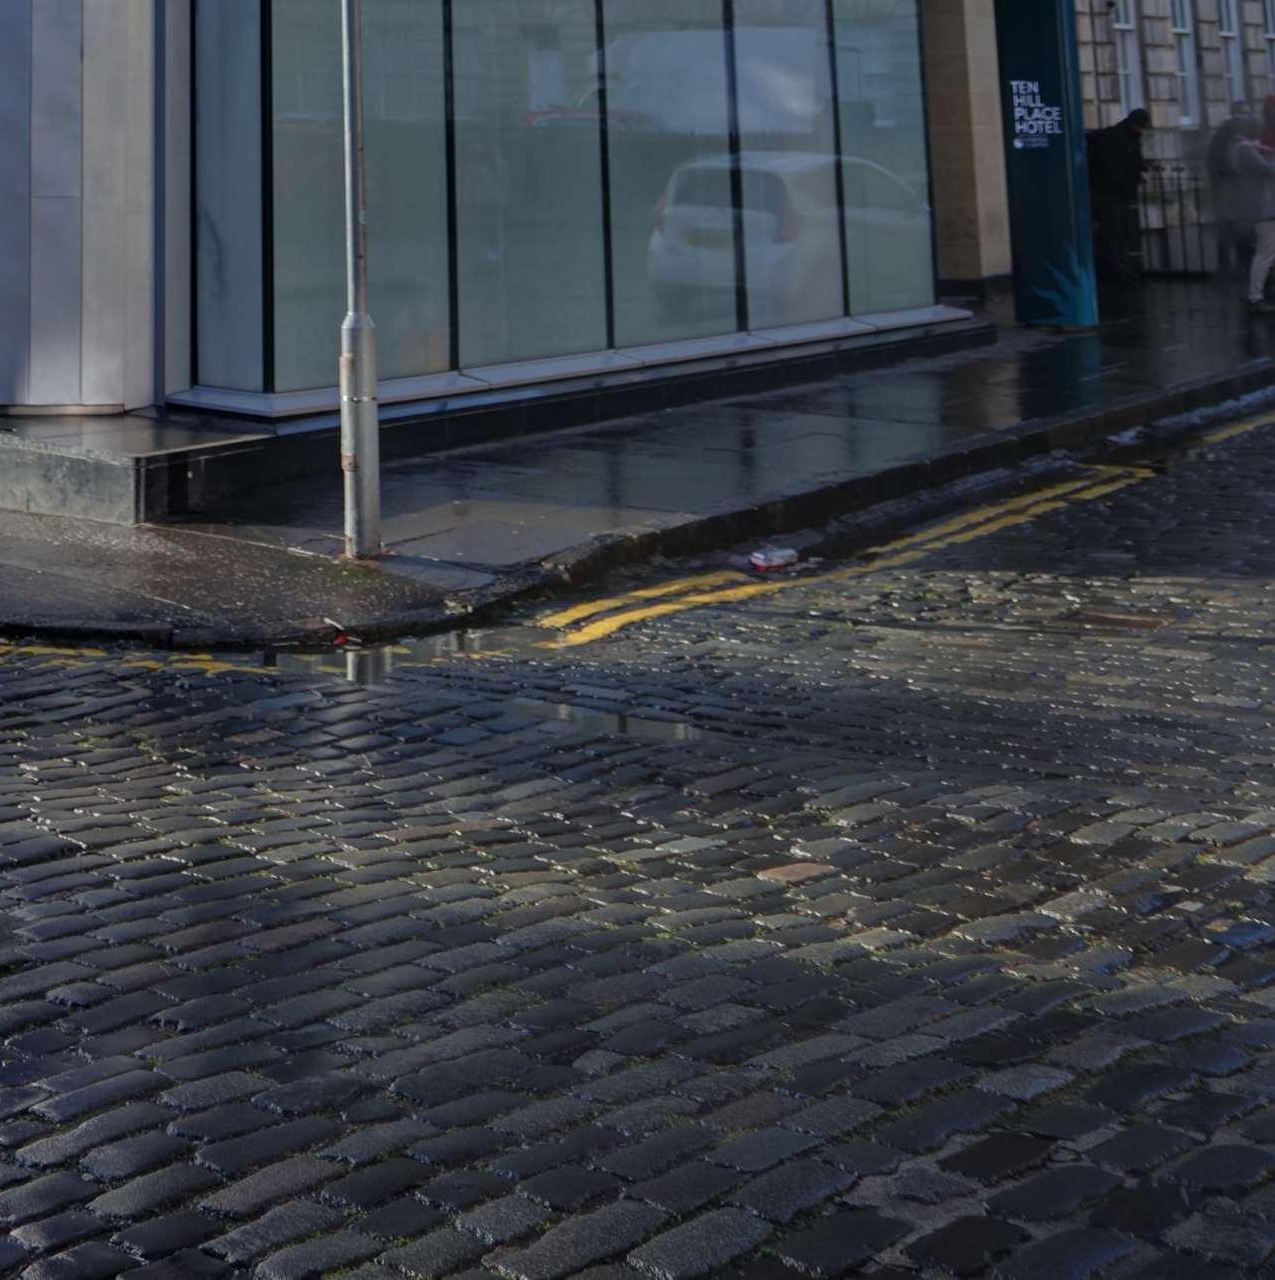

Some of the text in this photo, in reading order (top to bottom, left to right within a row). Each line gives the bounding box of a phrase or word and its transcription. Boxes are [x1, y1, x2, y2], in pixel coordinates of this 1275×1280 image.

[1009, 80, 1039, 94] TEN
[1013, 95, 1045, 107] HILL
[1014, 106, 1063, 120] PLACE
[1015, 120, 1063, 134] HOTEL
